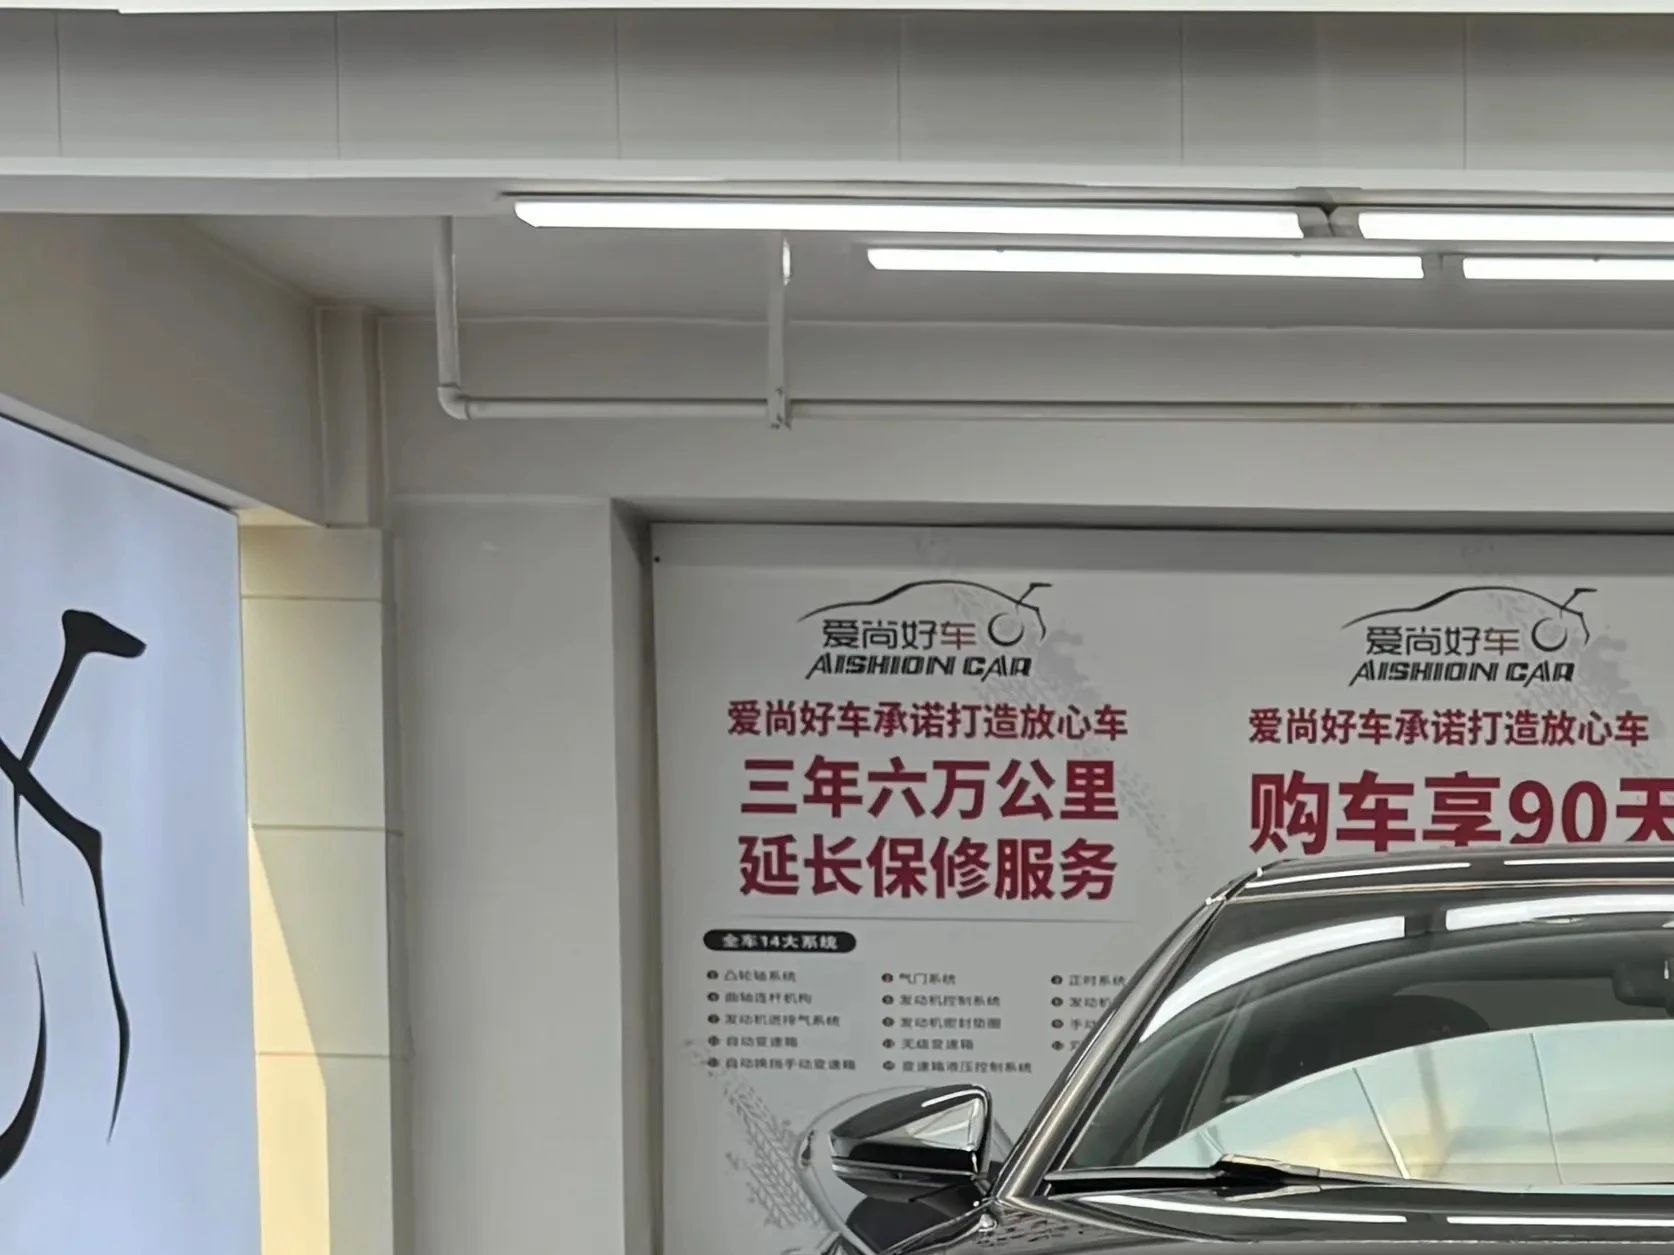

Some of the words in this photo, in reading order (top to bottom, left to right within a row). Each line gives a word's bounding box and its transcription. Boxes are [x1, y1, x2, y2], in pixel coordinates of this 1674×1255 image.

[822, 619, 977, 650] 爱尚好车
[1366, 626, 1520, 657] 爱尚好车
[806, 653, 955, 680] AISHION
[961, 656, 1032, 682] CAR
[1349, 660, 1499, 687] AISHION
[1505, 661, 1575, 688] CAR
[728, 700, 1128, 741] 爱尚好车承诺打造放心车
[1248, 707, 1650, 747] 爱尚好车承诺打造放心车
[740, 755, 1119, 821] 三年六万公里
[739, 834, 1118, 901] 延长保修服务
